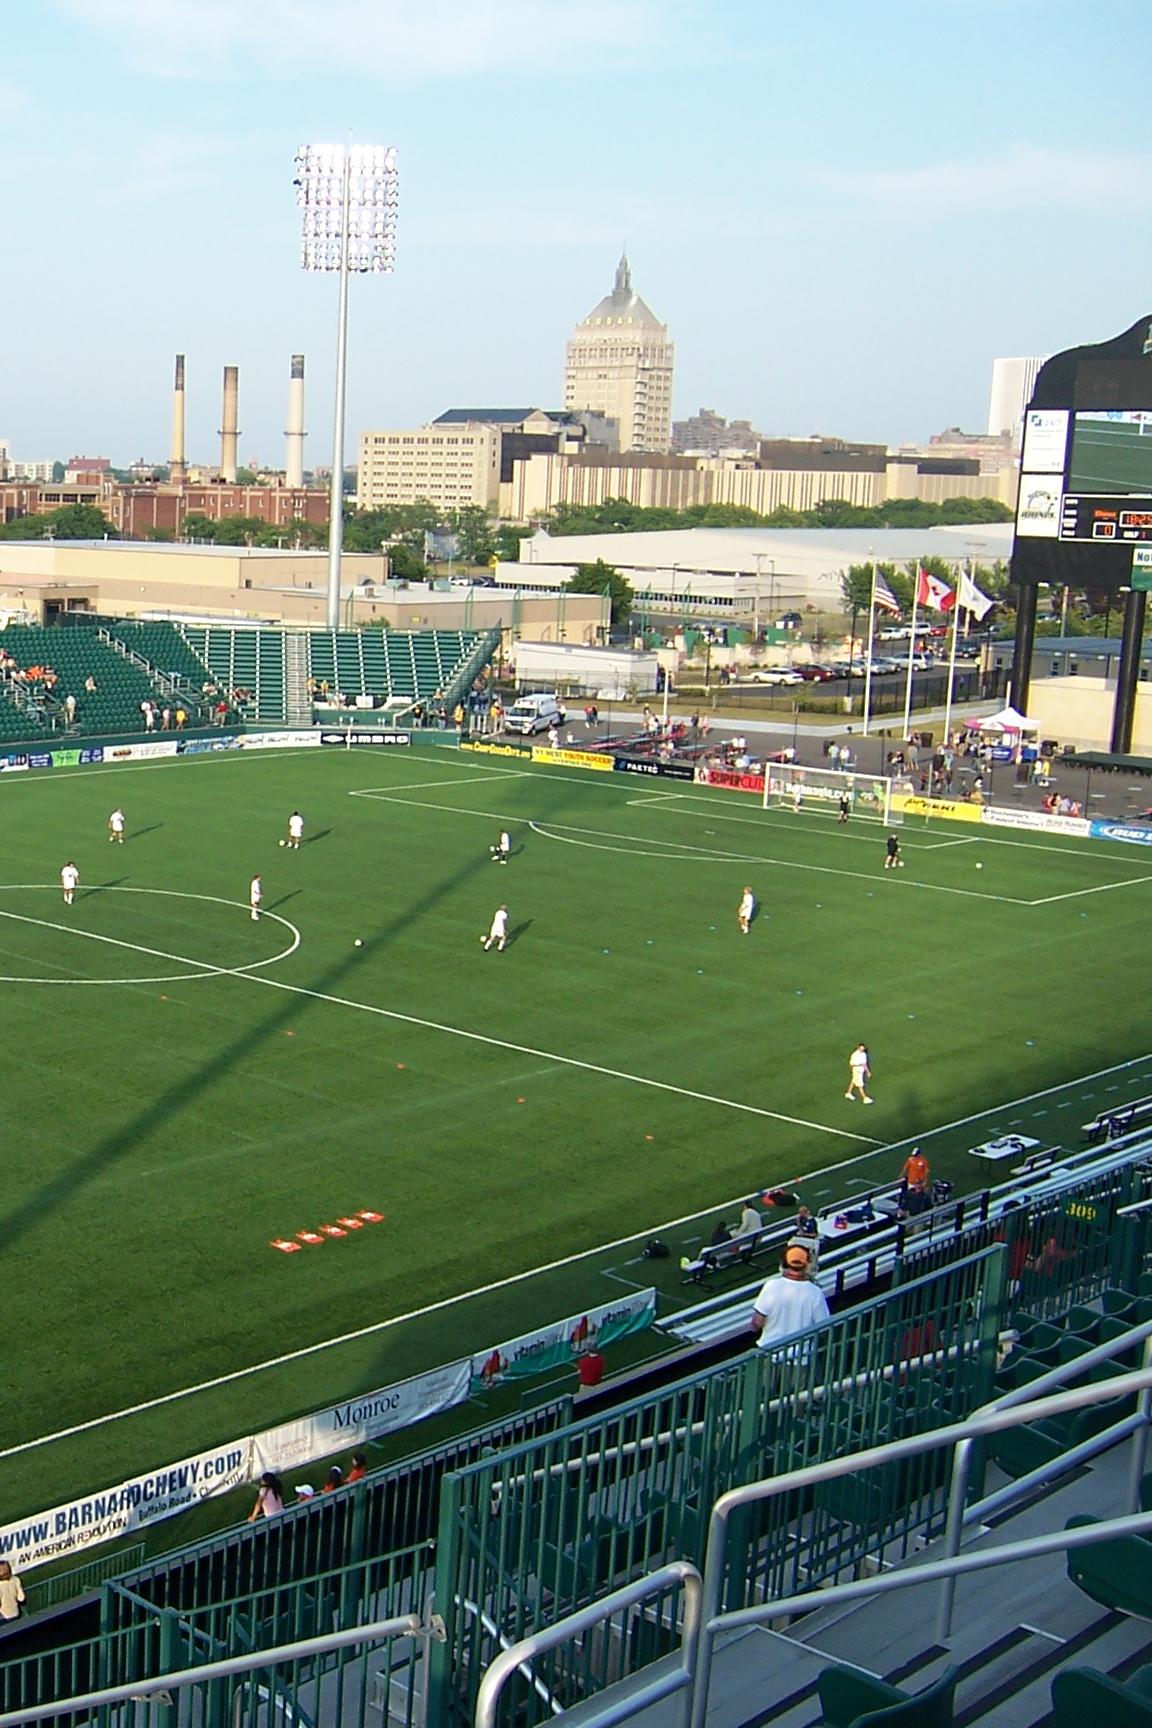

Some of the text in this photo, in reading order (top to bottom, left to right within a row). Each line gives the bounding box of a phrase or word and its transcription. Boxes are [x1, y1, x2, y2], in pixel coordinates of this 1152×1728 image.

[1136, 551, 1152, 562] No
[709, 771, 767, 791] SUPERCUT
[333, 1393, 400, 1431] Monroe
[169, 1491, 192, 1509] Road
